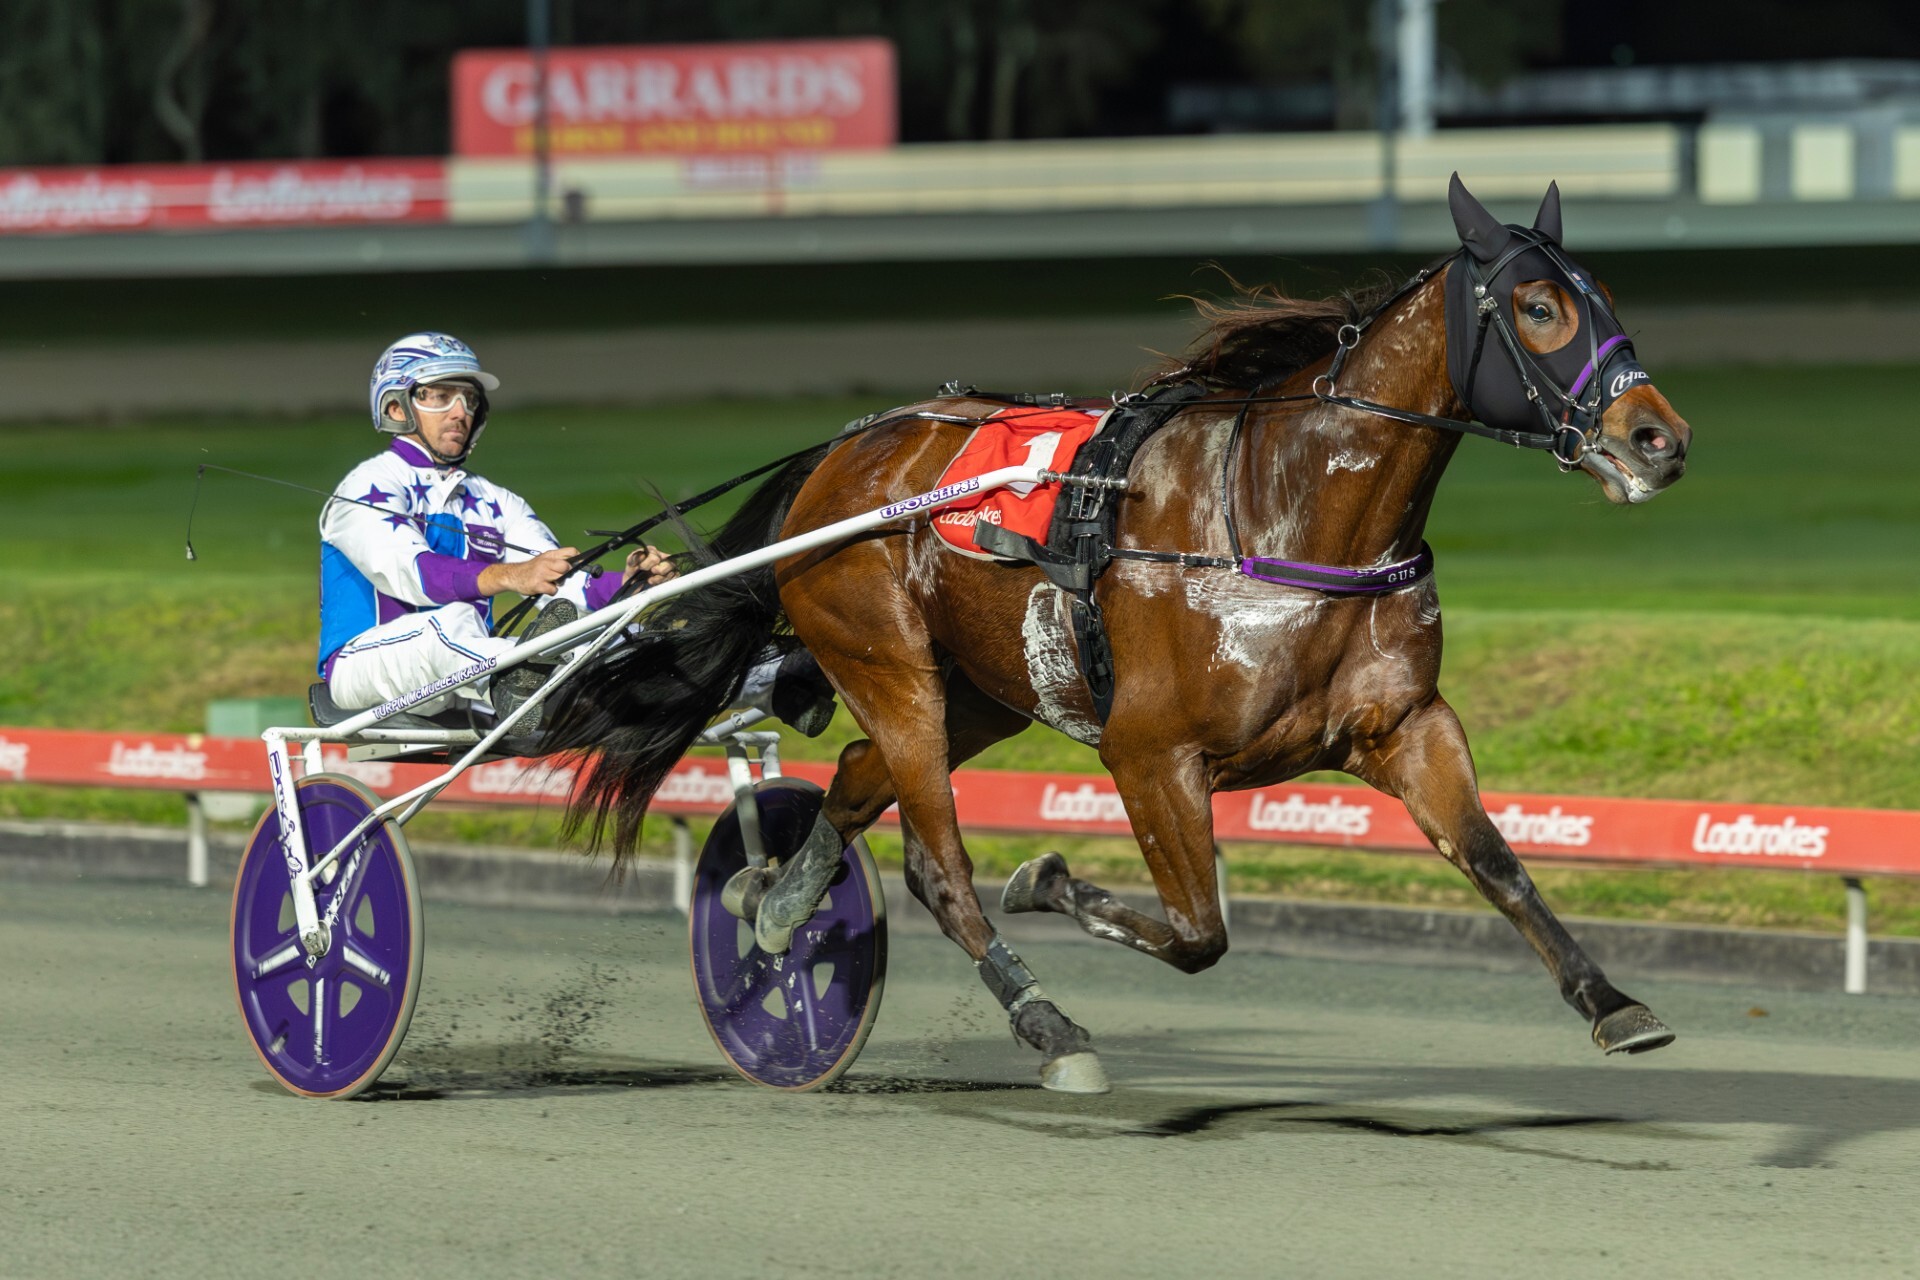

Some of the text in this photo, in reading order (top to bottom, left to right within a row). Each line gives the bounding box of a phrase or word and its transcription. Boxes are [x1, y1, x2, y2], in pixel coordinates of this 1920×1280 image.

[481, 54, 866, 126] GARRARDS
[1011, 431, 1063, 499] 1
[1388, 566, 1416, 583] GUS
[373, 695, 408, 719] TURPIN
[459, 655, 498, 681] RACING
[1247, 794, 1374, 836] Ladbrokes
[1692, 812, 1830, 858] Ladbrokes
